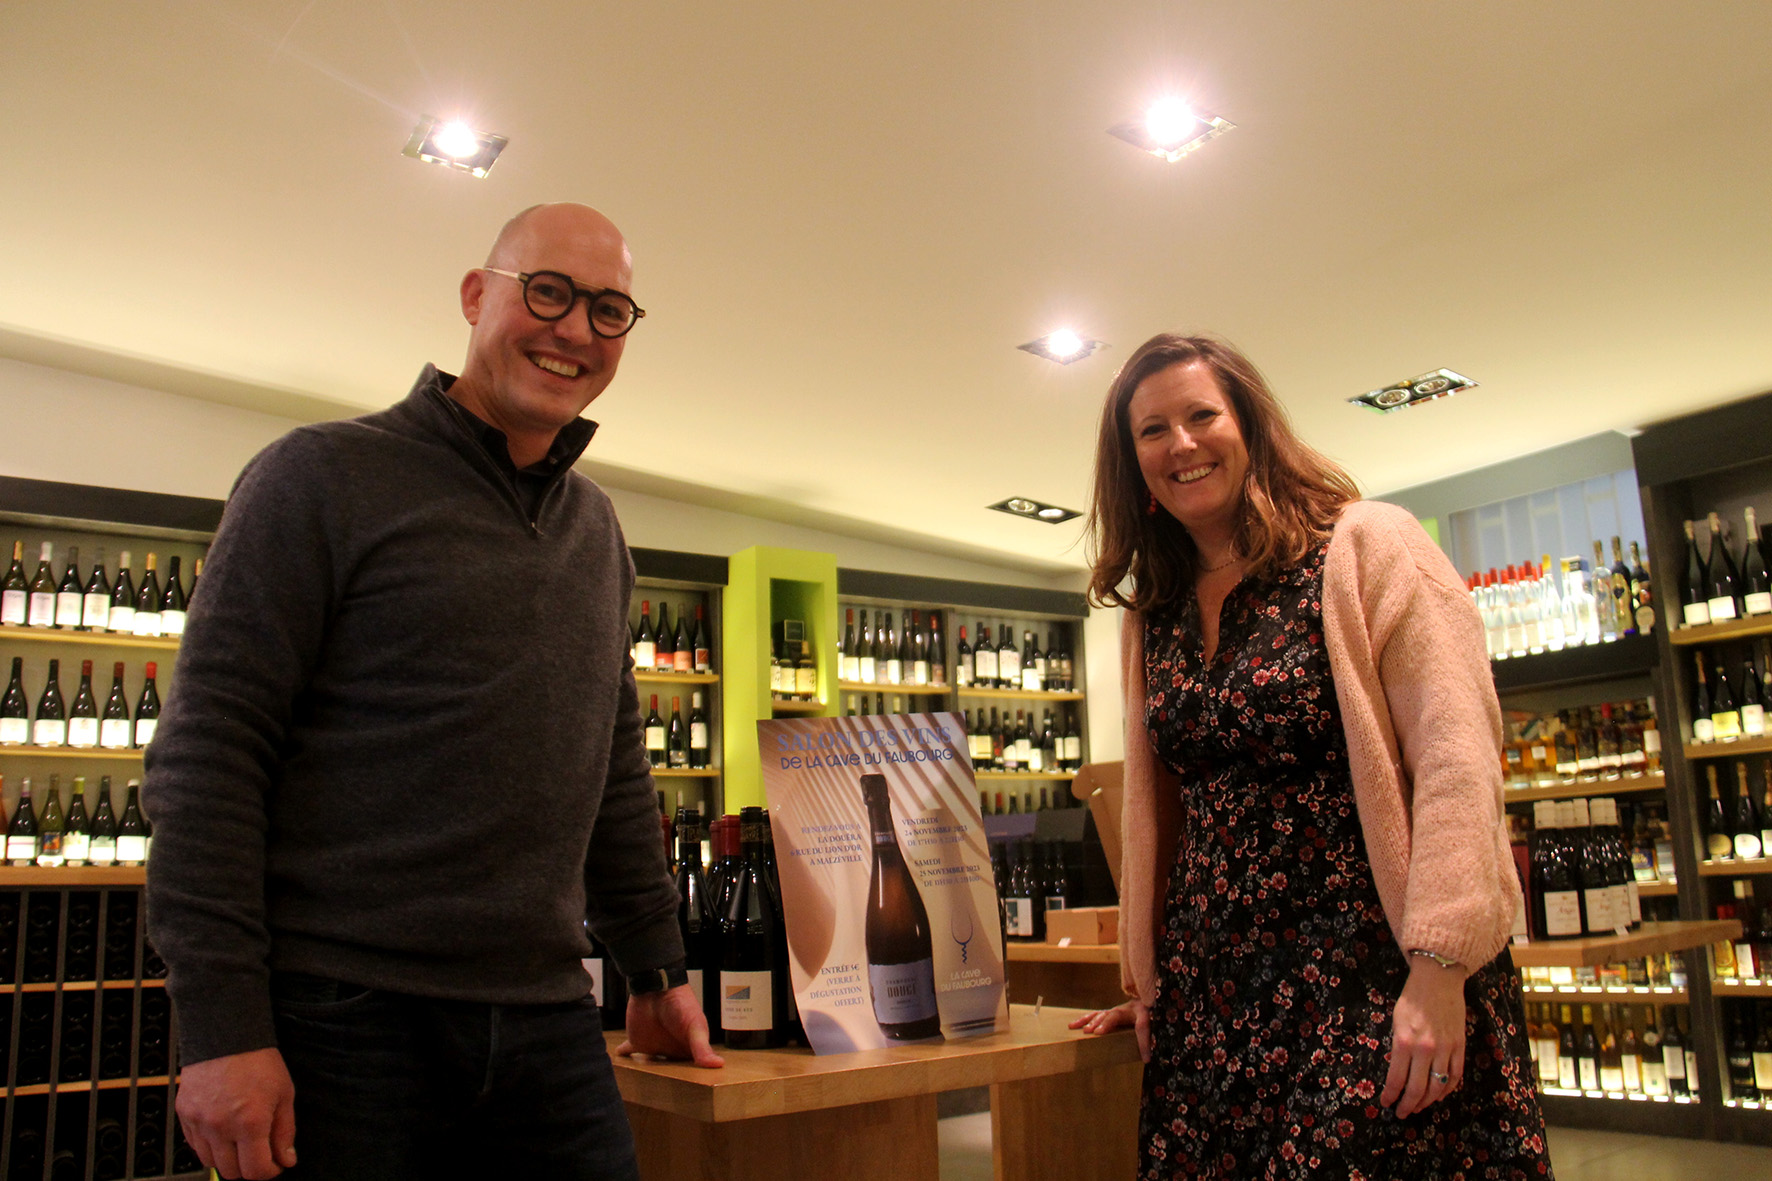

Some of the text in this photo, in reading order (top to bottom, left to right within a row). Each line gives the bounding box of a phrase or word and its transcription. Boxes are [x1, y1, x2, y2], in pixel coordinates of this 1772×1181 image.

[776, 726, 951, 752] SALON DES VINS
[806, 755, 823, 768] LA
[864, 752, 882, 765] DU
[885, 748, 954, 764] FAUBOURG
[901, 817, 939, 826] VENDREDI
[913, 826, 951, 836] NOVEMBRE
[796, 848, 812, 856] RUE
[812, 847, 824, 855] DU
[825, 845, 843, 854] LION
[914, 858, 941, 867] SAMEDI
[927, 866, 965, 876] NOVEMBRE
[821, 964, 849, 975] ENTRÉE
[950, 971, 961, 980] LA
[940, 977, 992, 992] DU FAUBOURG
[810, 986, 863, 1000] DÉGUSTATION
